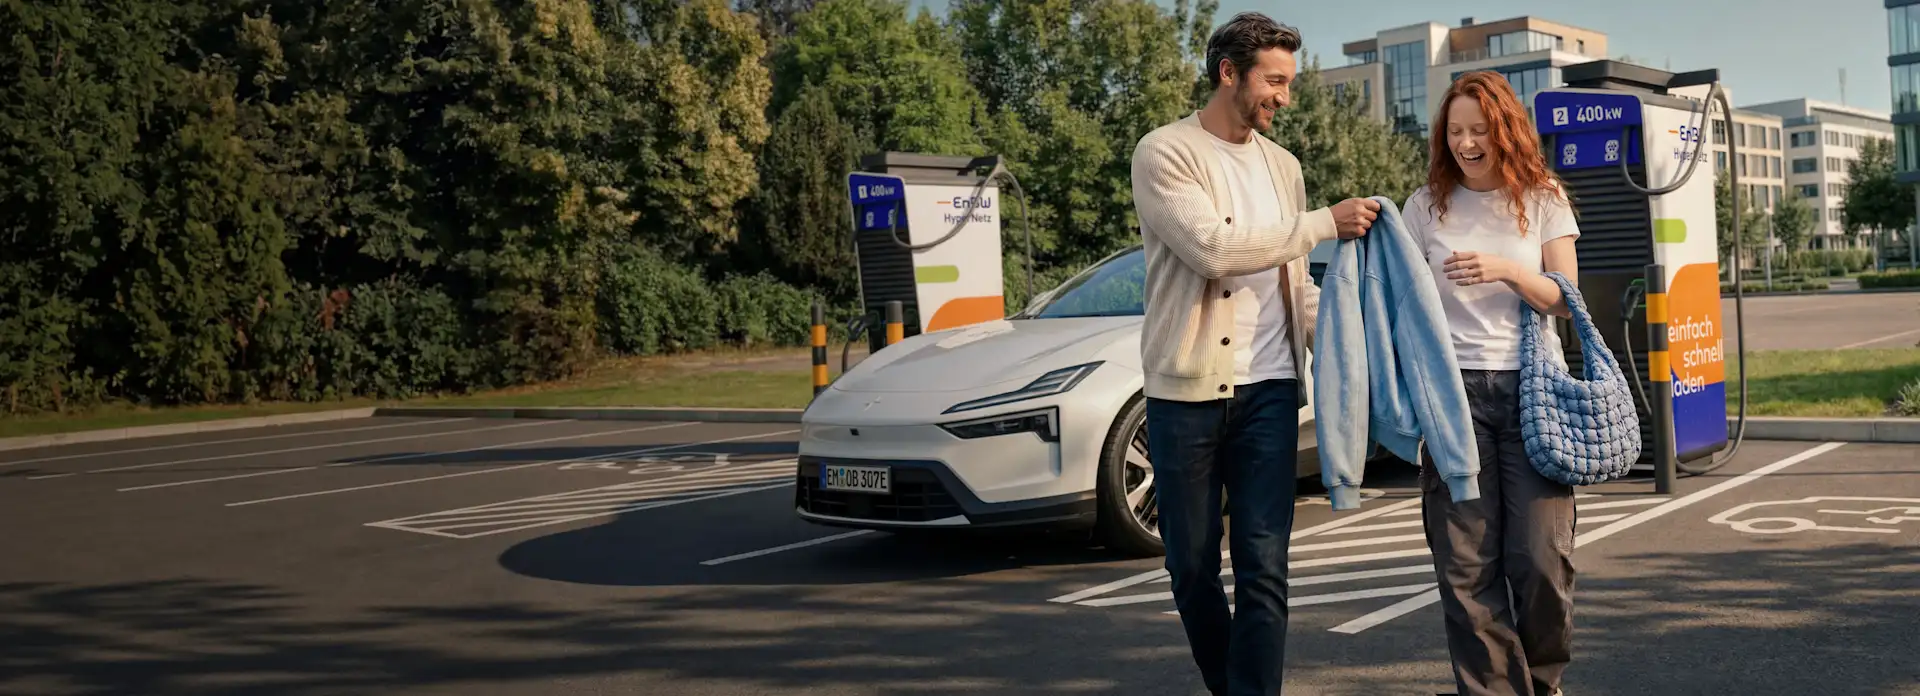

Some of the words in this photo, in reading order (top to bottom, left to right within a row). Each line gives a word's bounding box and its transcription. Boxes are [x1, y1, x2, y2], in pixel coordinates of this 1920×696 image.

[1556, 109, 1565, 123] 2
[1576, 105, 1604, 123] 400
[1605, 107, 1622, 120] kW
[1679, 125, 1707, 143] EnB
[870, 184, 885, 197] 400
[953, 196, 991, 209] EnBW
[1667, 314, 1714, 343] einfach
[1683, 338, 1724, 369] schnell
[1670, 371, 1705, 398] laden
[827, 468, 839, 486] EM
[846, 469, 859, 488] OB
[860, 470, 887, 489] 307E
